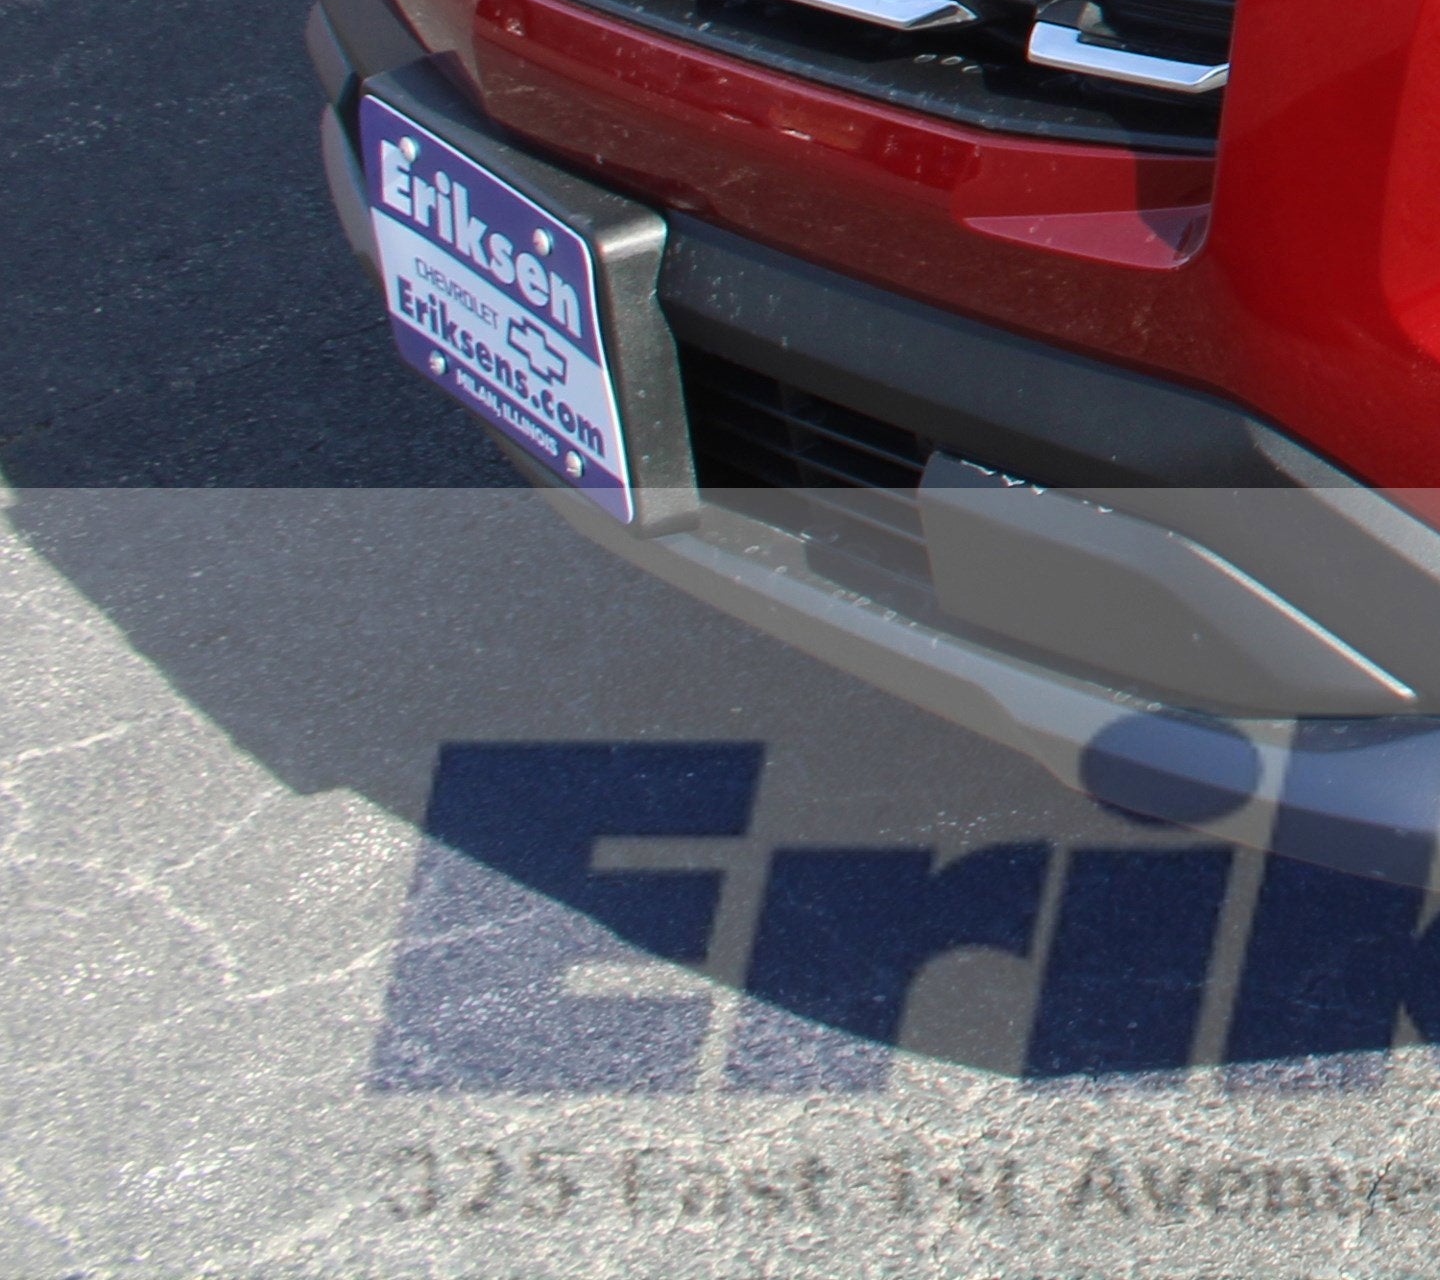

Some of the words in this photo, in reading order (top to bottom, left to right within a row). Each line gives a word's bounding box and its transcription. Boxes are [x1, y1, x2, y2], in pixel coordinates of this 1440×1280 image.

[380, 139, 582, 339] Eriksen
[415, 257, 501, 331] CHEVROLET
[397, 274, 605, 458] Eriksens.com
